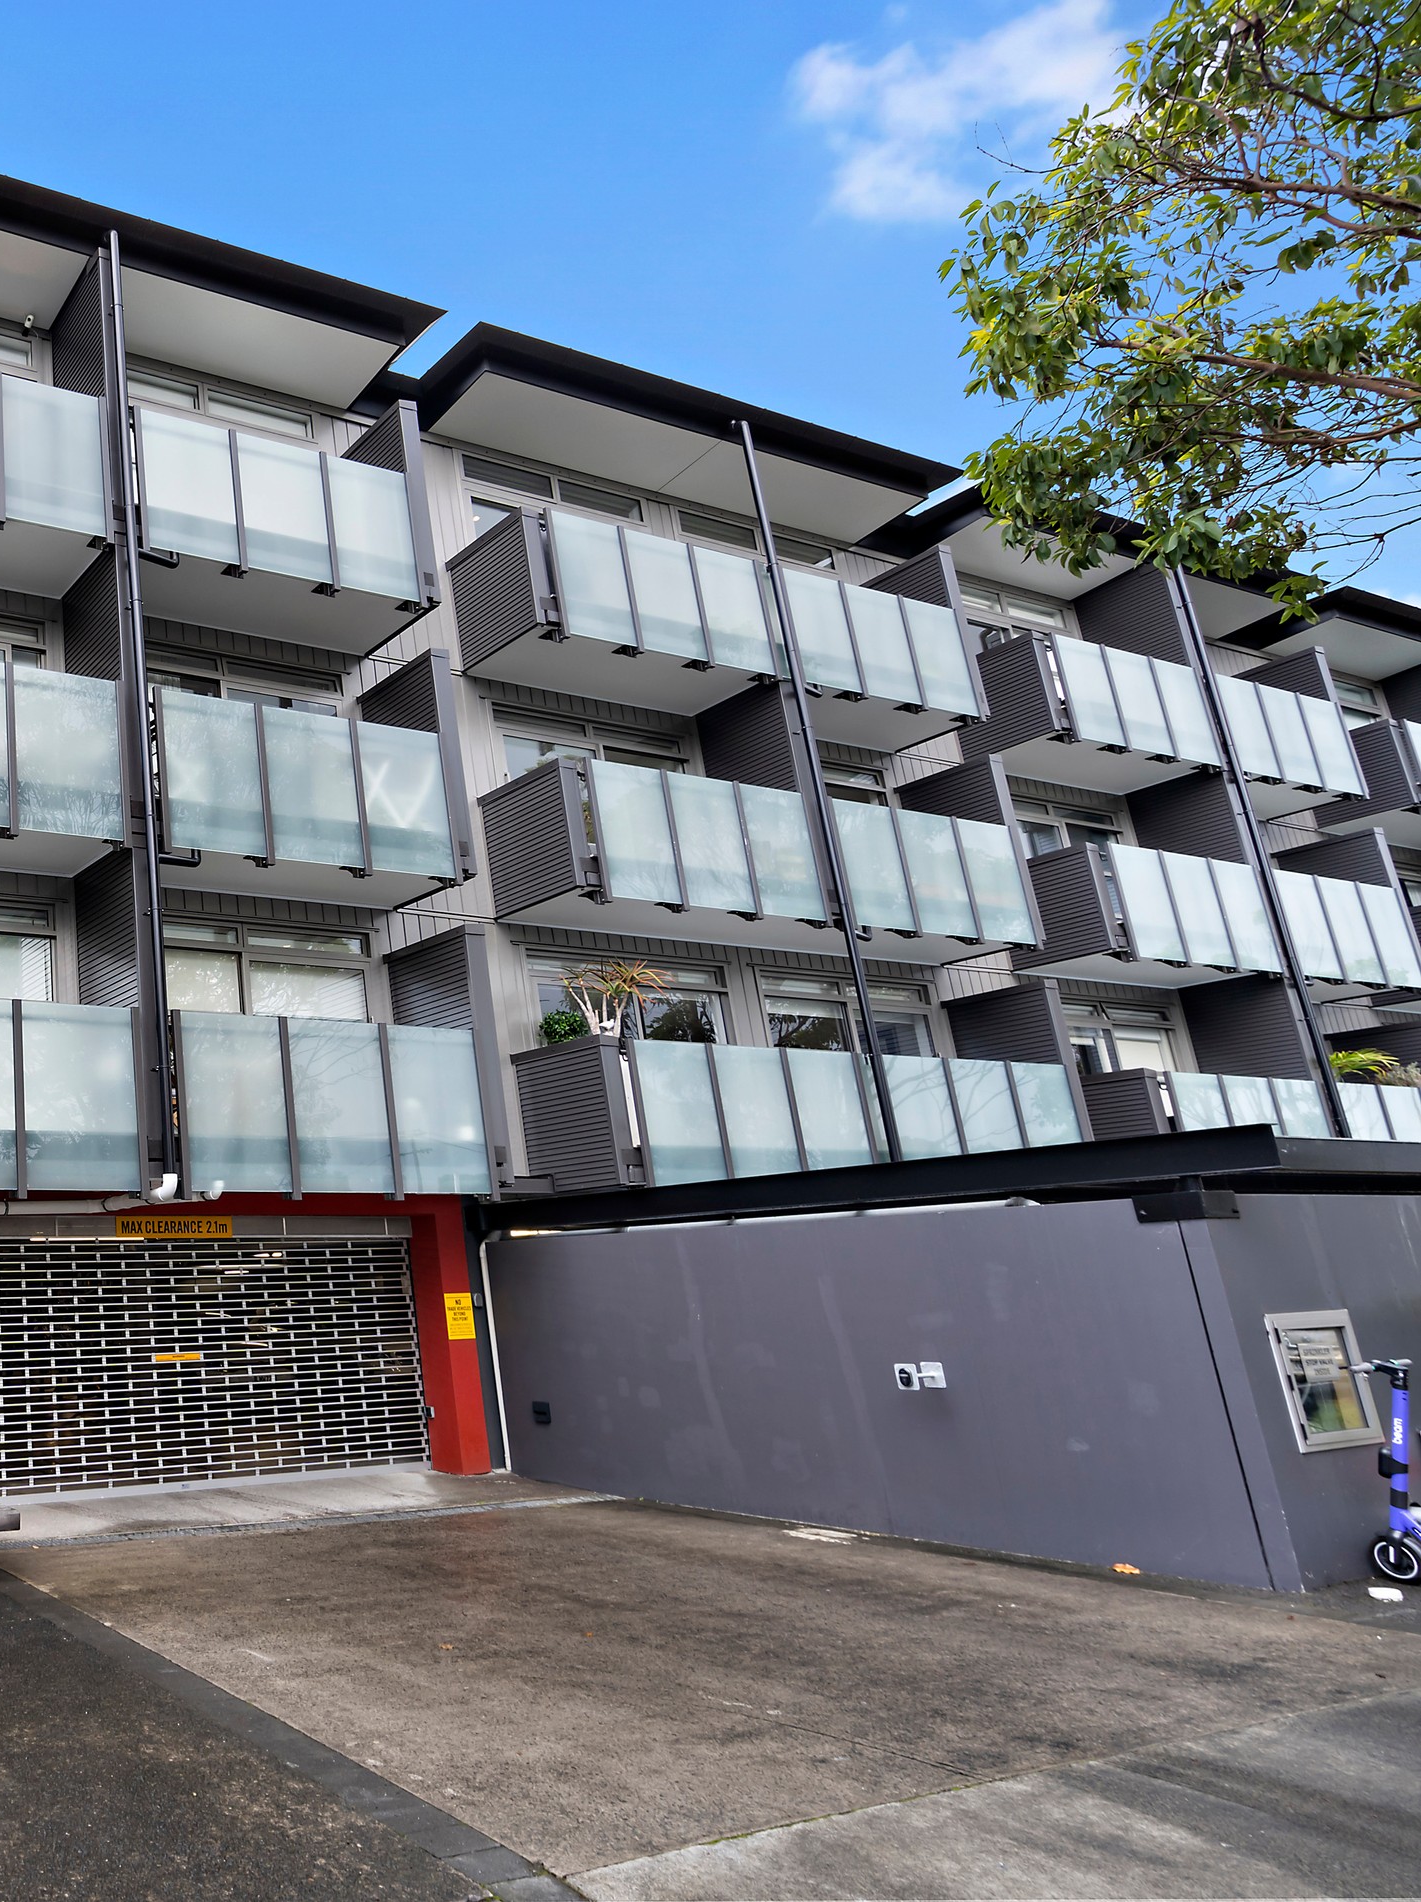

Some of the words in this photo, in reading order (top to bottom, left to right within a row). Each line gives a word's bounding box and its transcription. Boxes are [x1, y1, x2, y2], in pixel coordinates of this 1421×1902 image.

[121, 1220, 143, 1234] MAX
[145, 1220, 203, 1234] CLEARANCE
[206, 1220, 228, 1234] 2.1m
[1392, 1418, 1403, 1444] beam
